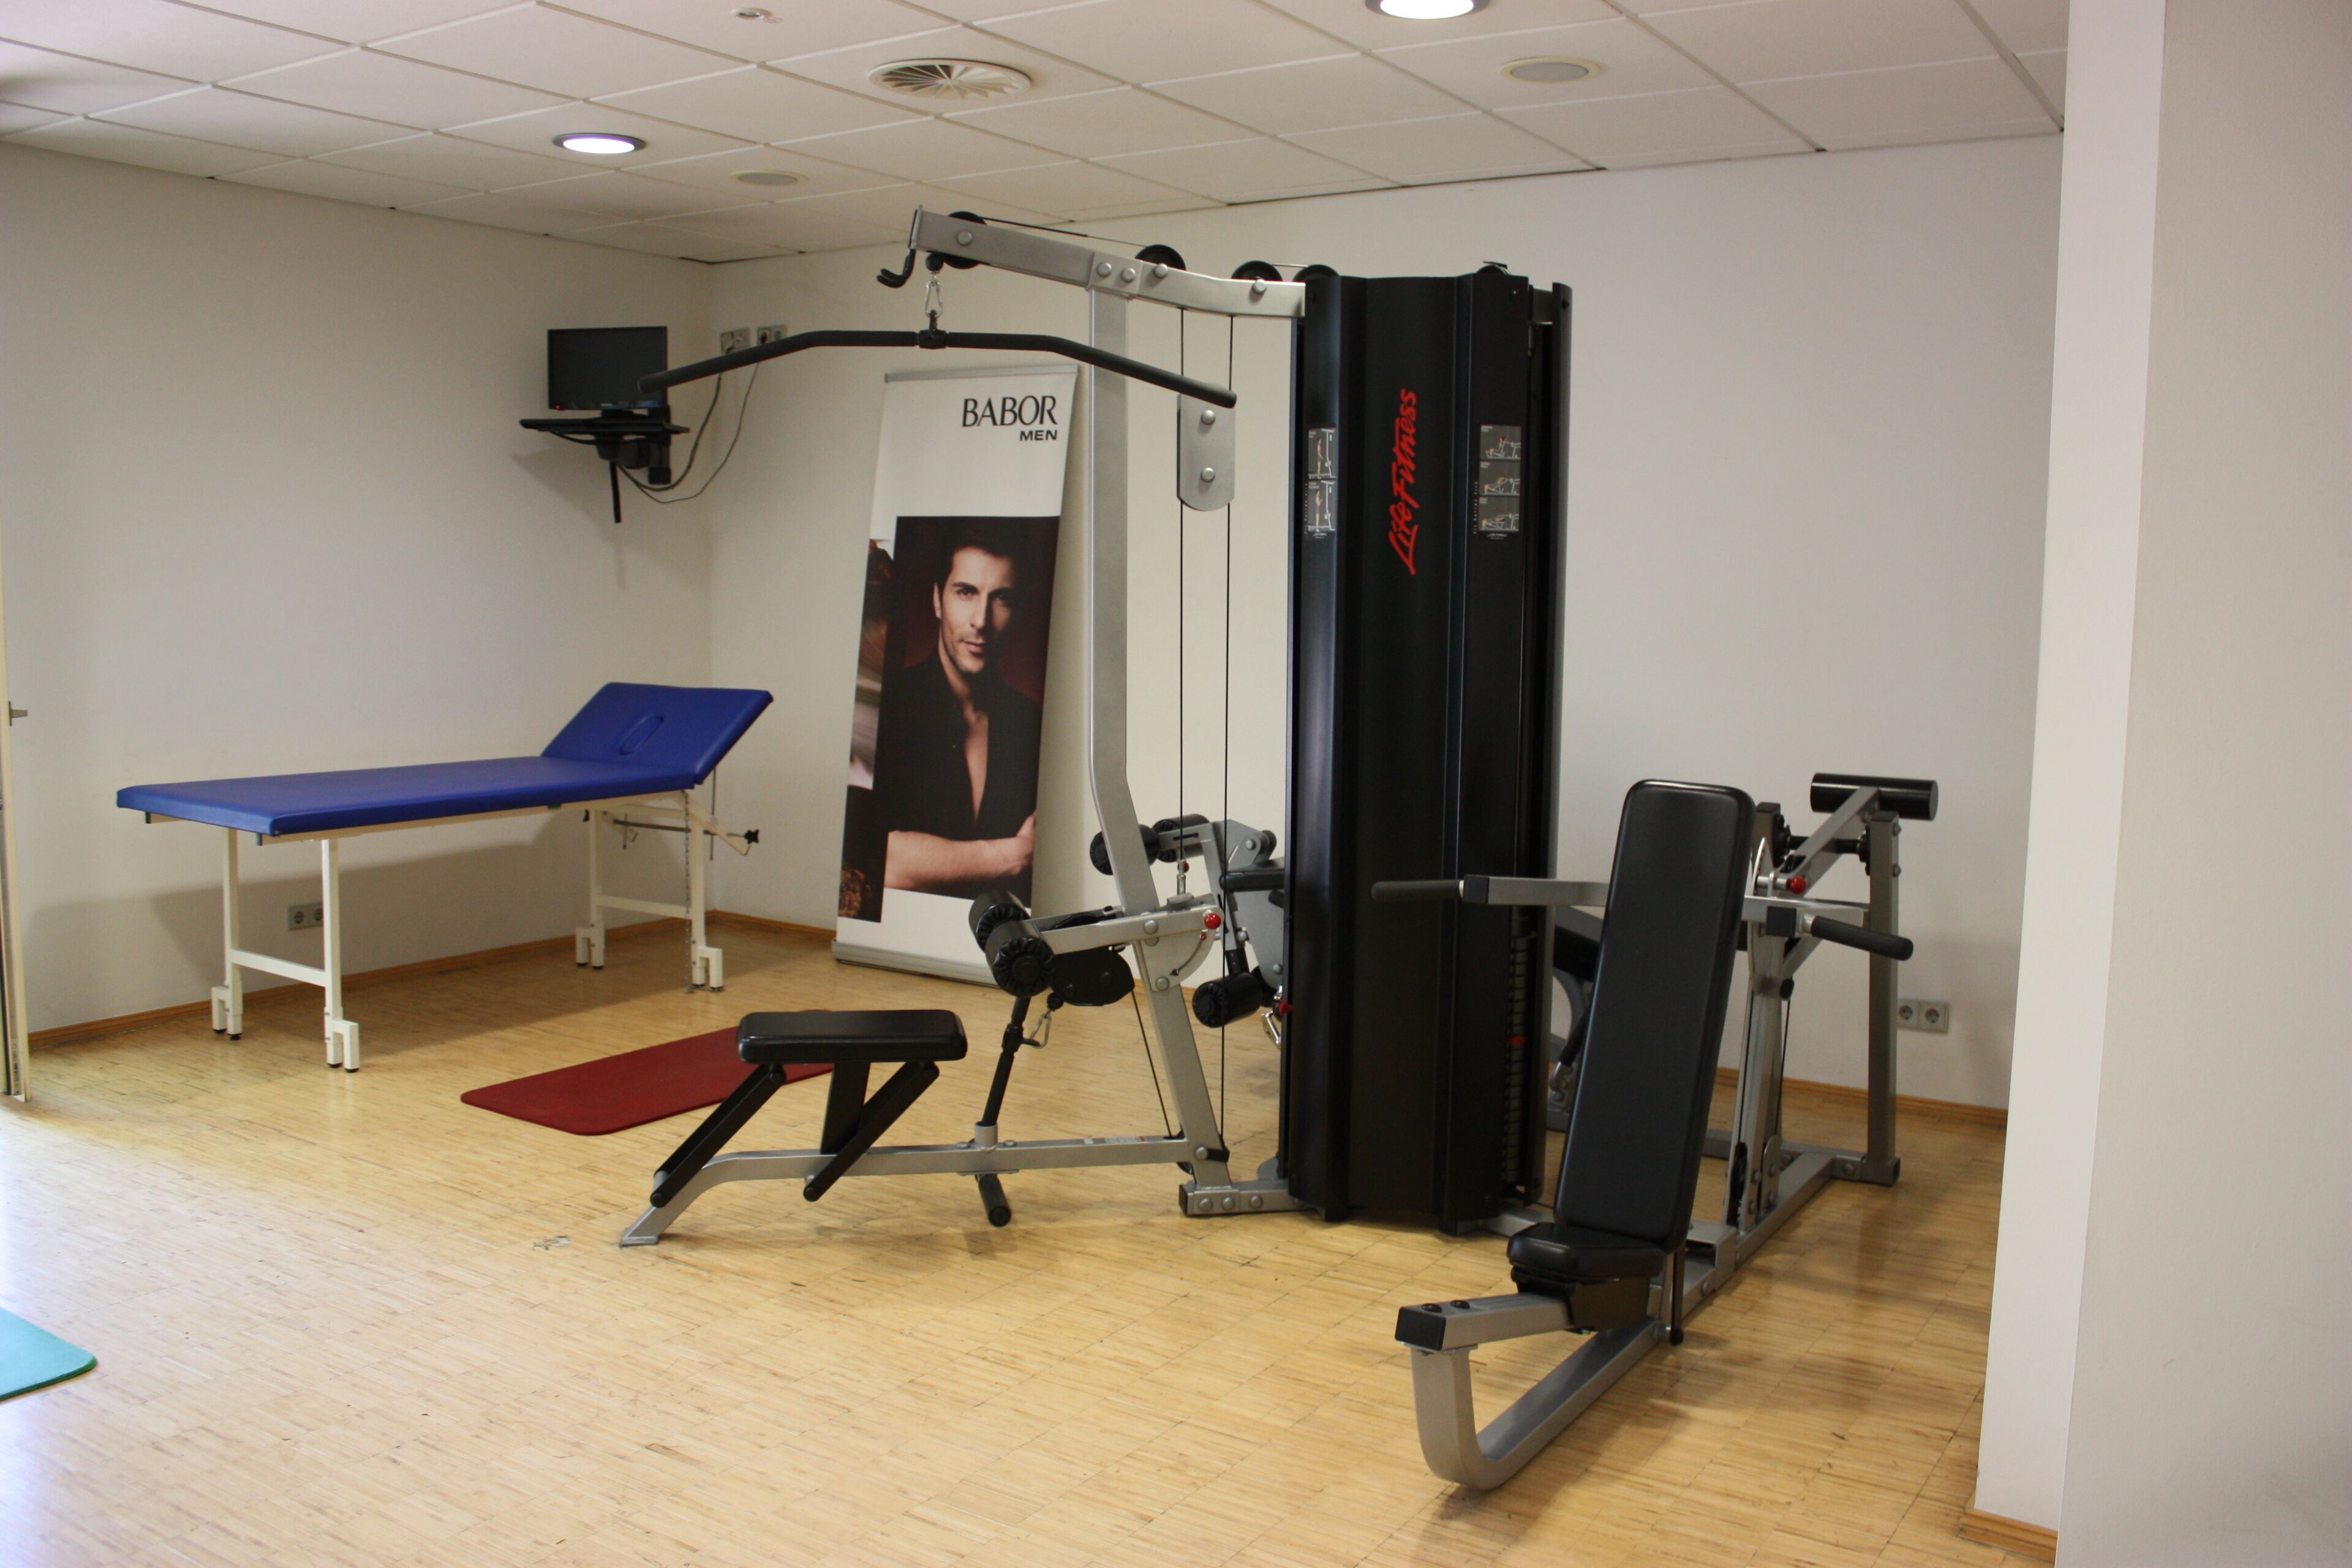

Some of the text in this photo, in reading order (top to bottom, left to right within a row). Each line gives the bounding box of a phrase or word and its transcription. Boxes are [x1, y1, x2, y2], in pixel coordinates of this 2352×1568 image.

[962, 395, 1058, 427] BABOR
[1019, 429, 1058, 442] MEN
[1389, 389, 1420, 575] Life Fitness
